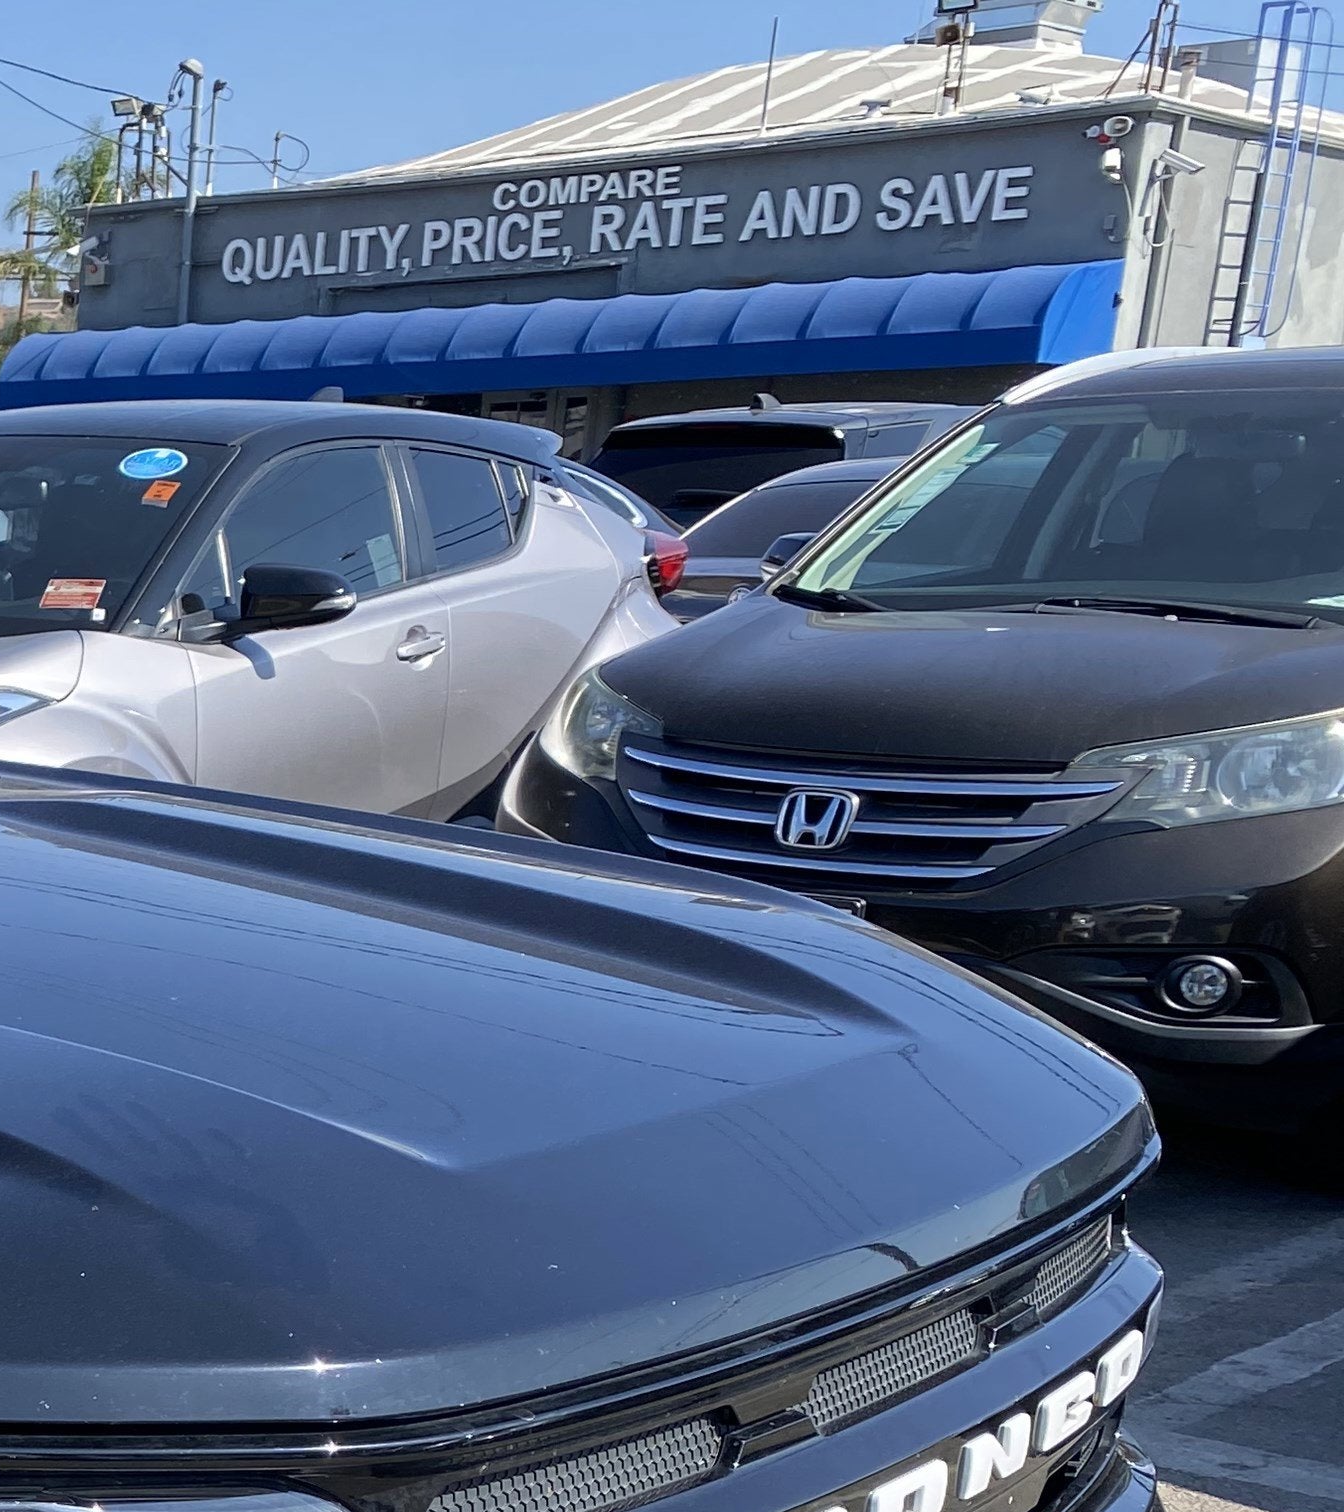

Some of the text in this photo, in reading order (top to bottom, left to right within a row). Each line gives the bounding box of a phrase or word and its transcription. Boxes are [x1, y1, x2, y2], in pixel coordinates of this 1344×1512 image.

[221, 165, 1034, 286] QUALITY, PRICE, RATE AND SAVE
[492, 165, 684, 211] COMPARE
